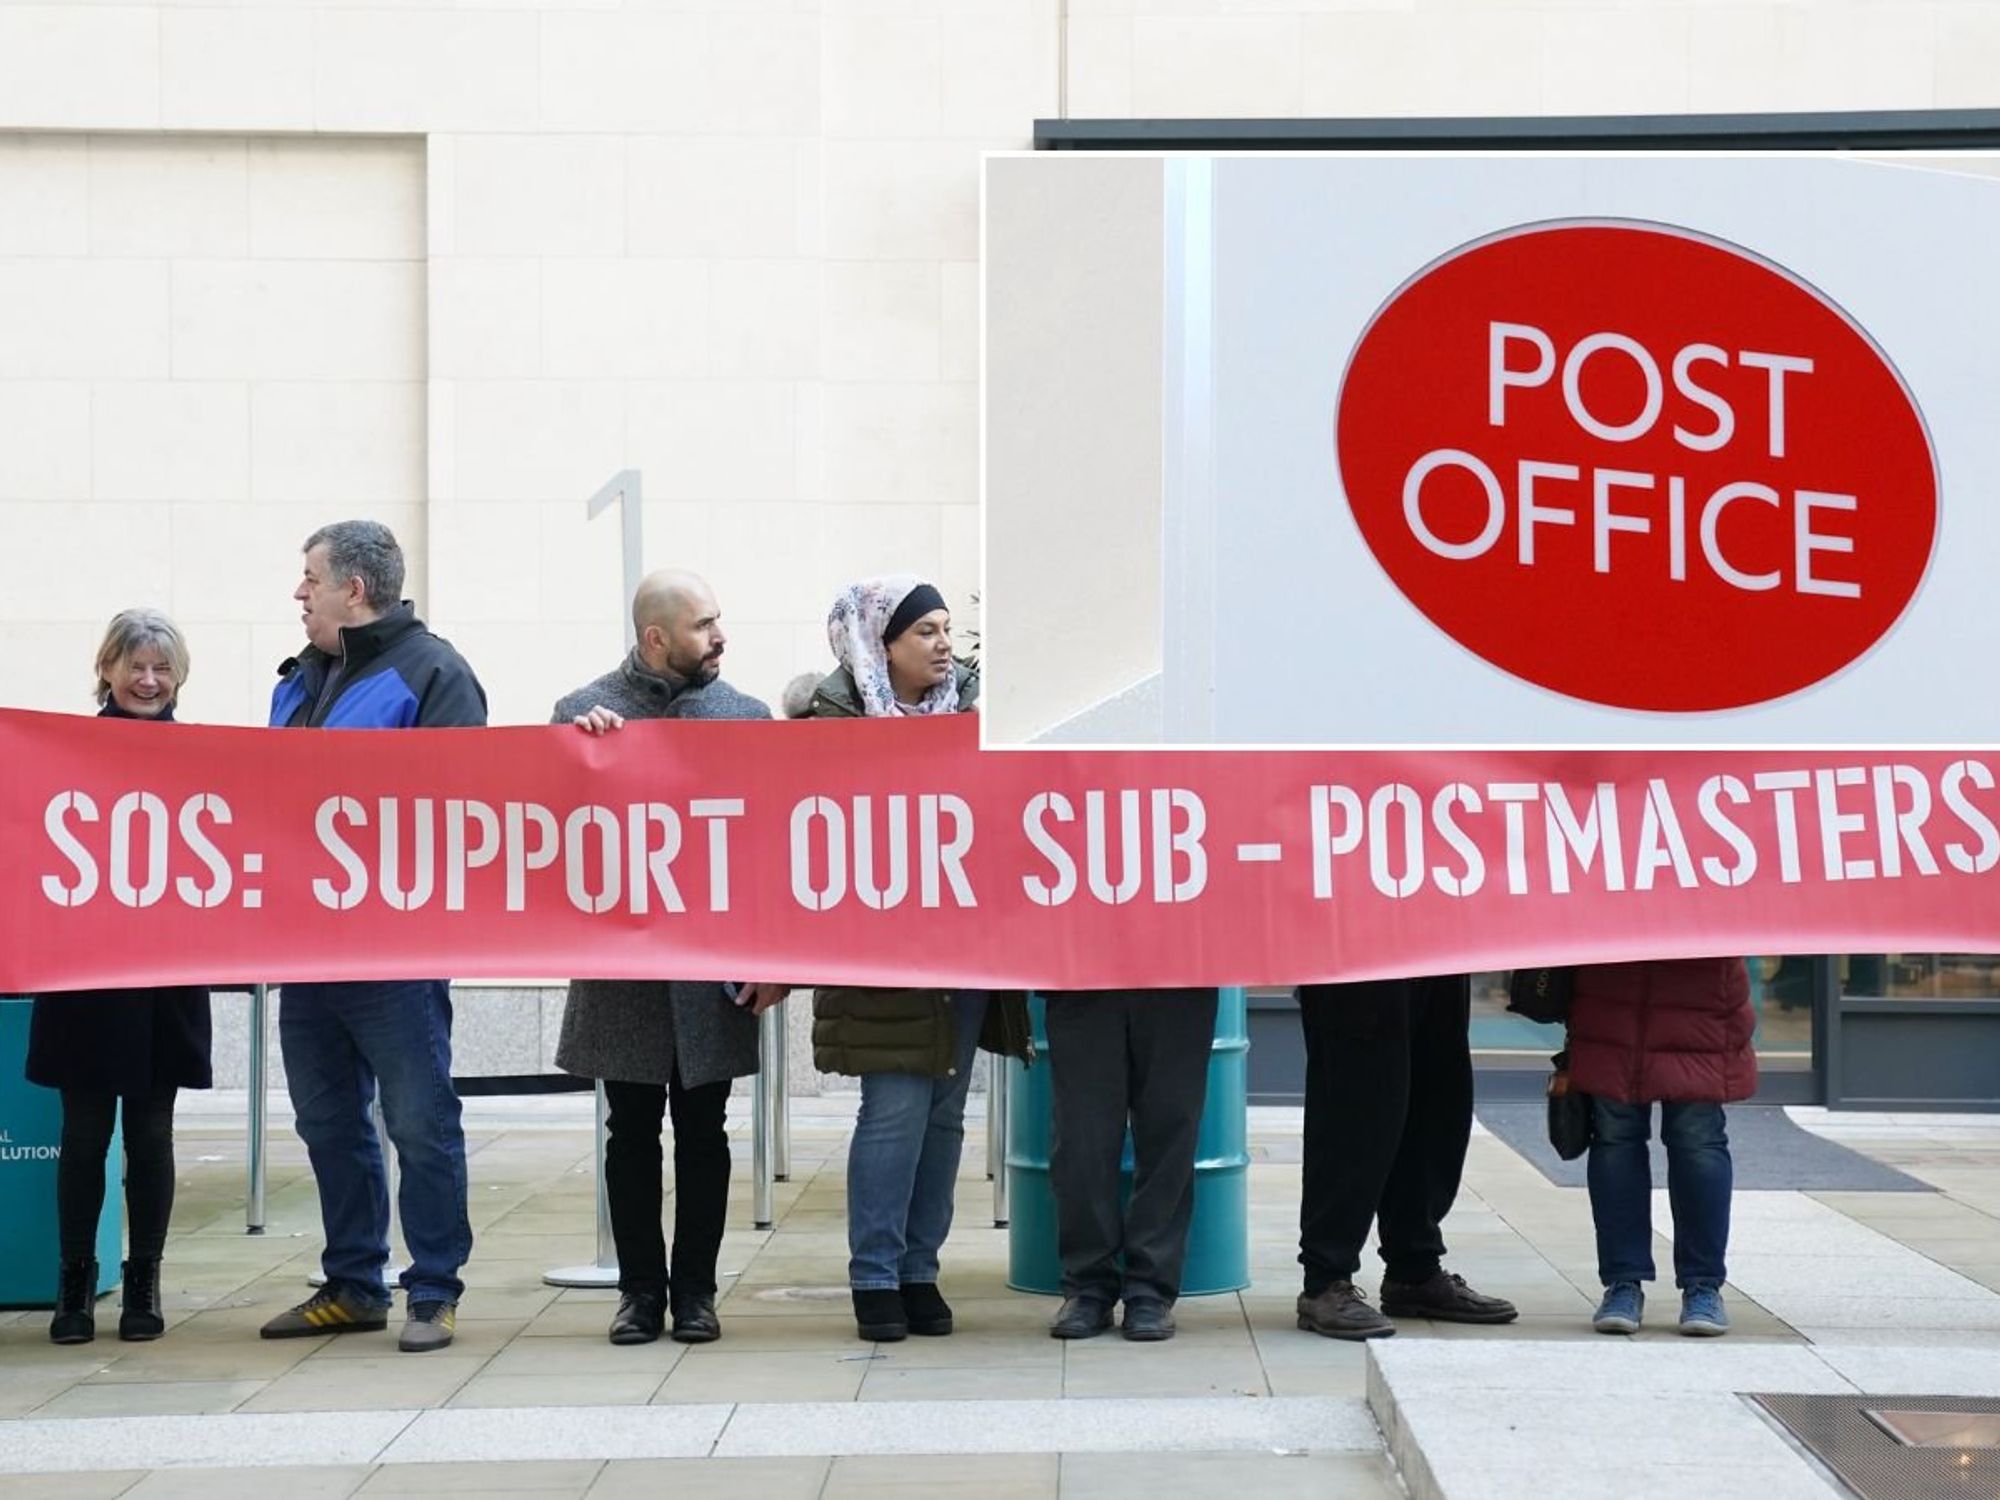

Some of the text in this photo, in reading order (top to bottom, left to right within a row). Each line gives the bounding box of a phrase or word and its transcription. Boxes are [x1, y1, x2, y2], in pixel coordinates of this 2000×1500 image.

[1489, 320, 1814, 457] POST
[1402, 448, 1861, 598] OFFICE
[41, 790, 262, 908] SOS:
[312, 796, 745, 914] SUPPORT
[790, 794, 978, 911] OUR
[1022, 788, 1208, 906] SUB
[1310, 760, 2000, 899] POSTMASTERS
[0, 1146, 62, 1160] LUTION
